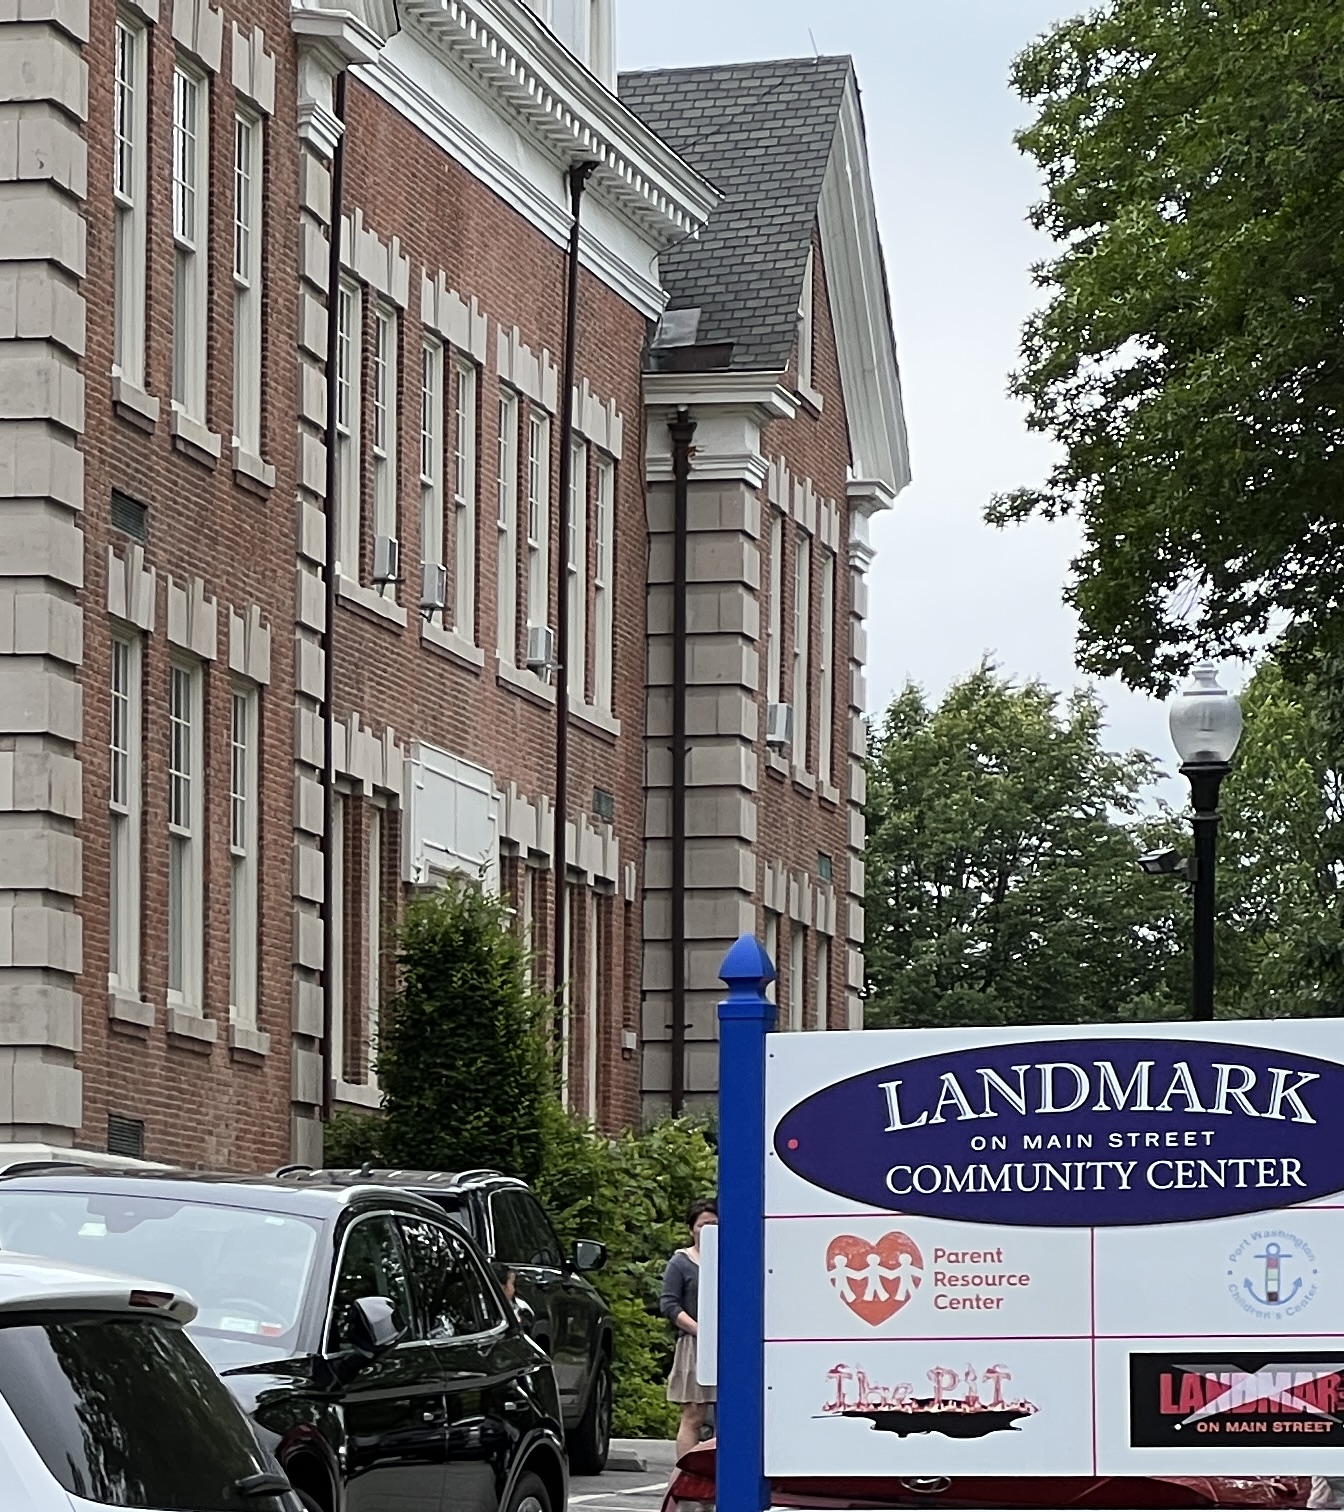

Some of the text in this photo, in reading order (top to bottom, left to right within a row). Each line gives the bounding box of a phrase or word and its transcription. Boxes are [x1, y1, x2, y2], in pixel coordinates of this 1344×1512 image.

[877, 1060, 1321, 1132] LANDMARK
[970, 1131, 1215, 1151] ON MAIN STREET
[885, 1158, 1307, 1195] COMMUNITY CENTER
[933, 1247, 1003, 1264] Parent
[1229, 1239, 1251, 1262] Port
[933, 1271, 1031, 1287] Resource
[933, 1294, 1004, 1310] Center
[1196, 1421, 1333, 1433] ON MAIN STREET
